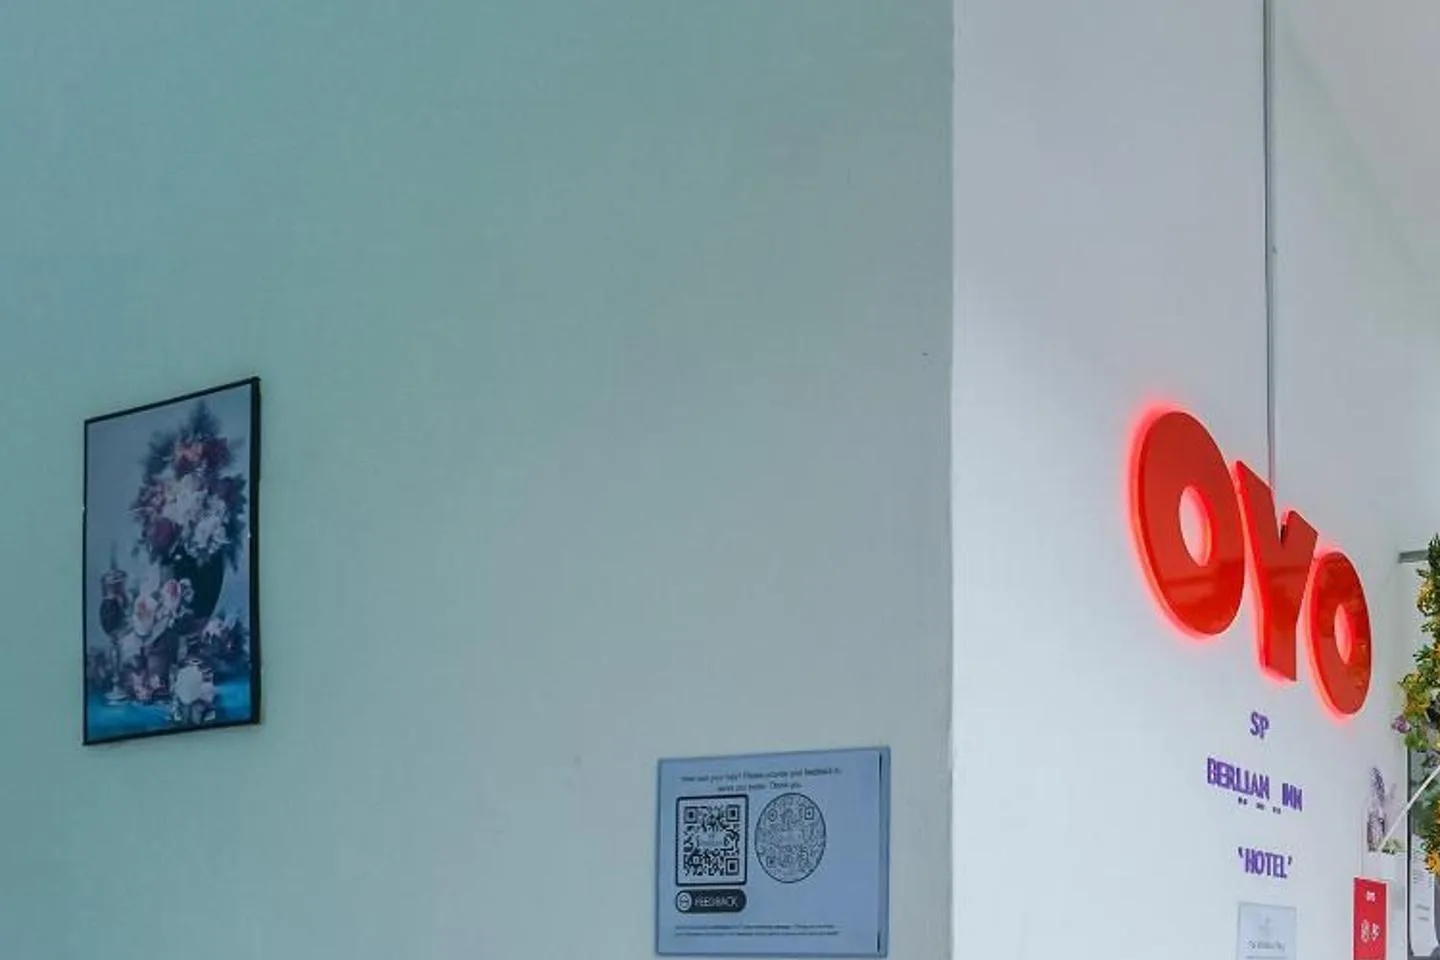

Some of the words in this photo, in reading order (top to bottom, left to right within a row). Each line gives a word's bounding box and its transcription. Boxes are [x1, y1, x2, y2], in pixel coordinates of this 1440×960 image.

[1132, 408, 1373, 718] OYO
[1249, 711, 1270, 739] SP
[1206, 757, 1270, 801] BERLIAN
[1282, 782, 1303, 812] INN
